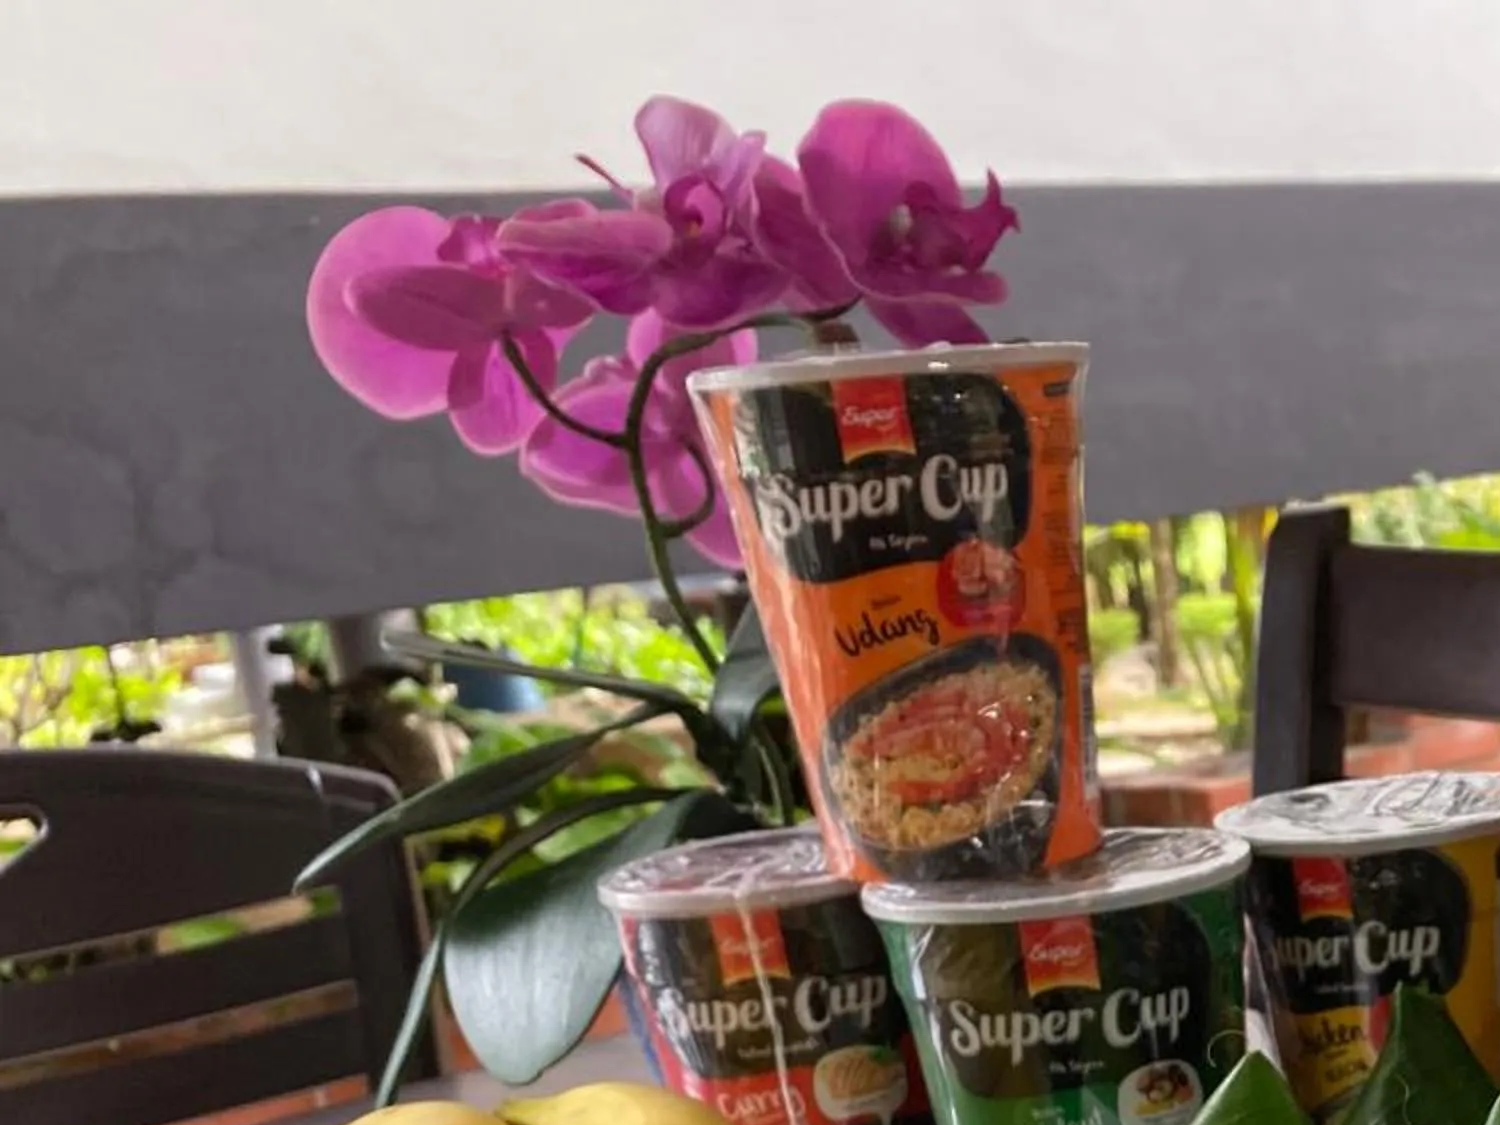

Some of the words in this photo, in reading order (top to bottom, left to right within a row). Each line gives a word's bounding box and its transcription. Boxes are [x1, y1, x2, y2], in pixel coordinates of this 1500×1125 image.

[756, 470, 914, 543] Super
[921, 455, 1009, 522] Cup
[1273, 934, 1349, 979] uper
[1355, 920, 1441, 976] Cup
[795, 976, 888, 1033] Cup
[950, 1001, 1095, 1064] Super
[1102, 986, 1191, 1049] Cup
